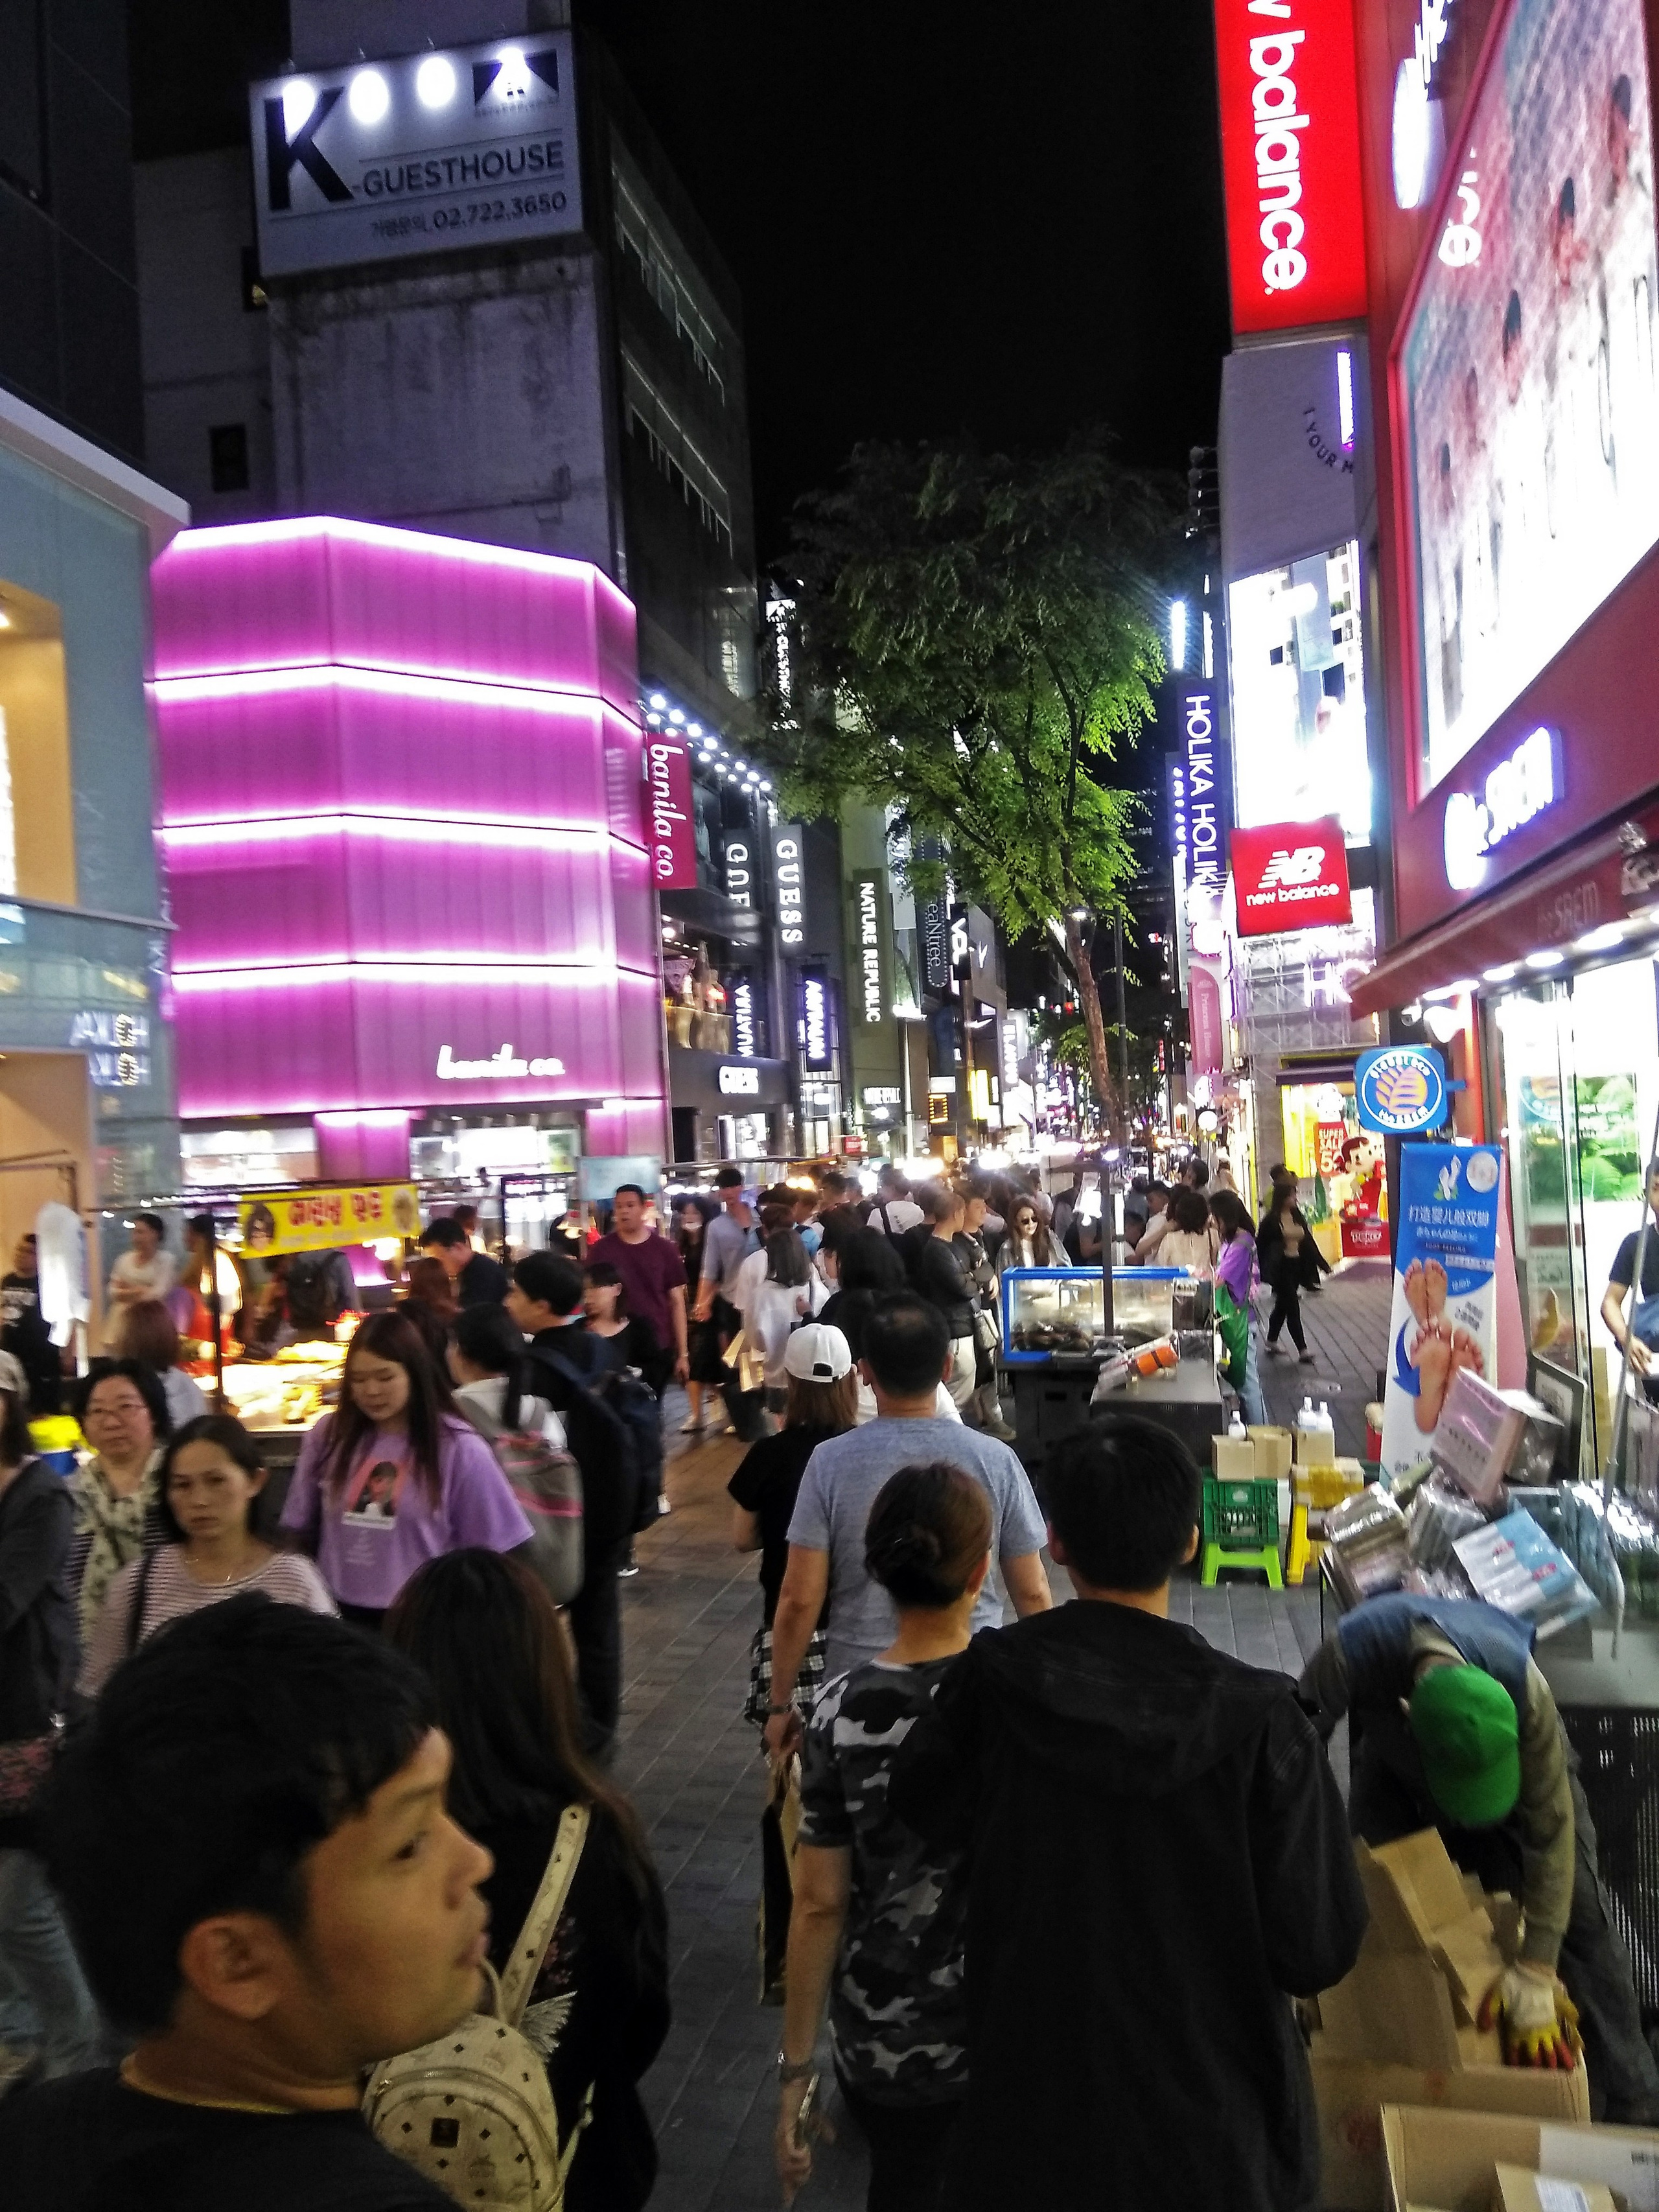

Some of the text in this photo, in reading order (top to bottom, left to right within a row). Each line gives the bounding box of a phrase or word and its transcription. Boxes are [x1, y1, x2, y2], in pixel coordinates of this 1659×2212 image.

[1249, 30, 1309, 290] balance
[1306, 421, 1336, 467] YOUR
[649, 742, 687, 881] banila co.
[1185, 694, 1219, 896] HOLIKA HOLIK
[776, 839, 804, 944] GUESS
[927, 896, 943, 968] eaNtree
[1246, 883, 1340, 906] new balance
[860, 882, 882, 1023] NATURE REPUBLIC
[1318, 1128, 1344, 1139] SUPER
